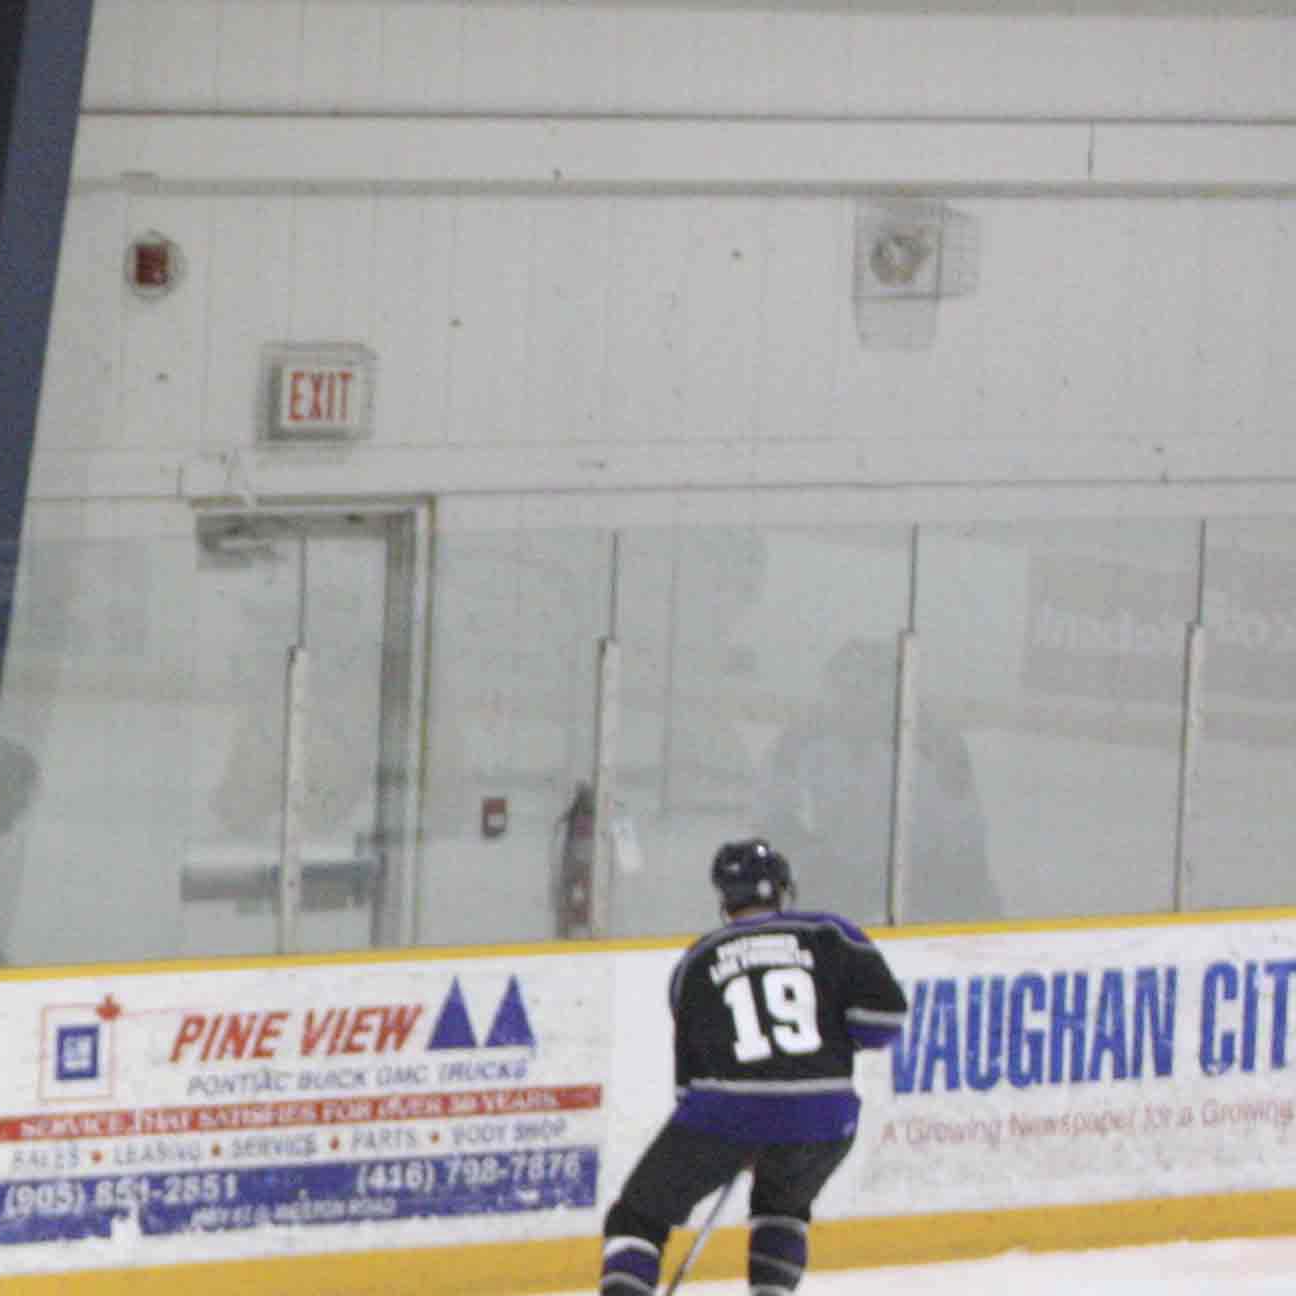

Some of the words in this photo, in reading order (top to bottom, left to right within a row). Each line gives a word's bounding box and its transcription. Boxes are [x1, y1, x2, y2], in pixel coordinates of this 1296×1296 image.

[288, 369, 352, 424] EXIT
[168, 1010, 290, 1064] PINE
[300, 1002, 423, 1056] VIEW
[724, 966, 823, 1062] 19
[892, 965, 1178, 1095] VAUGHAN
[1199, 961, 1296, 1076] CIT
[187, 1068, 290, 1097] PONTIAC
[297, 1064, 368, 1091] BUICK
[375, 1062, 430, 1087] GMC
[352, 1126, 418, 1151] PARTS
[2, 1179, 85, 1220] (905)
[358, 1160, 436, 1195] (416)
